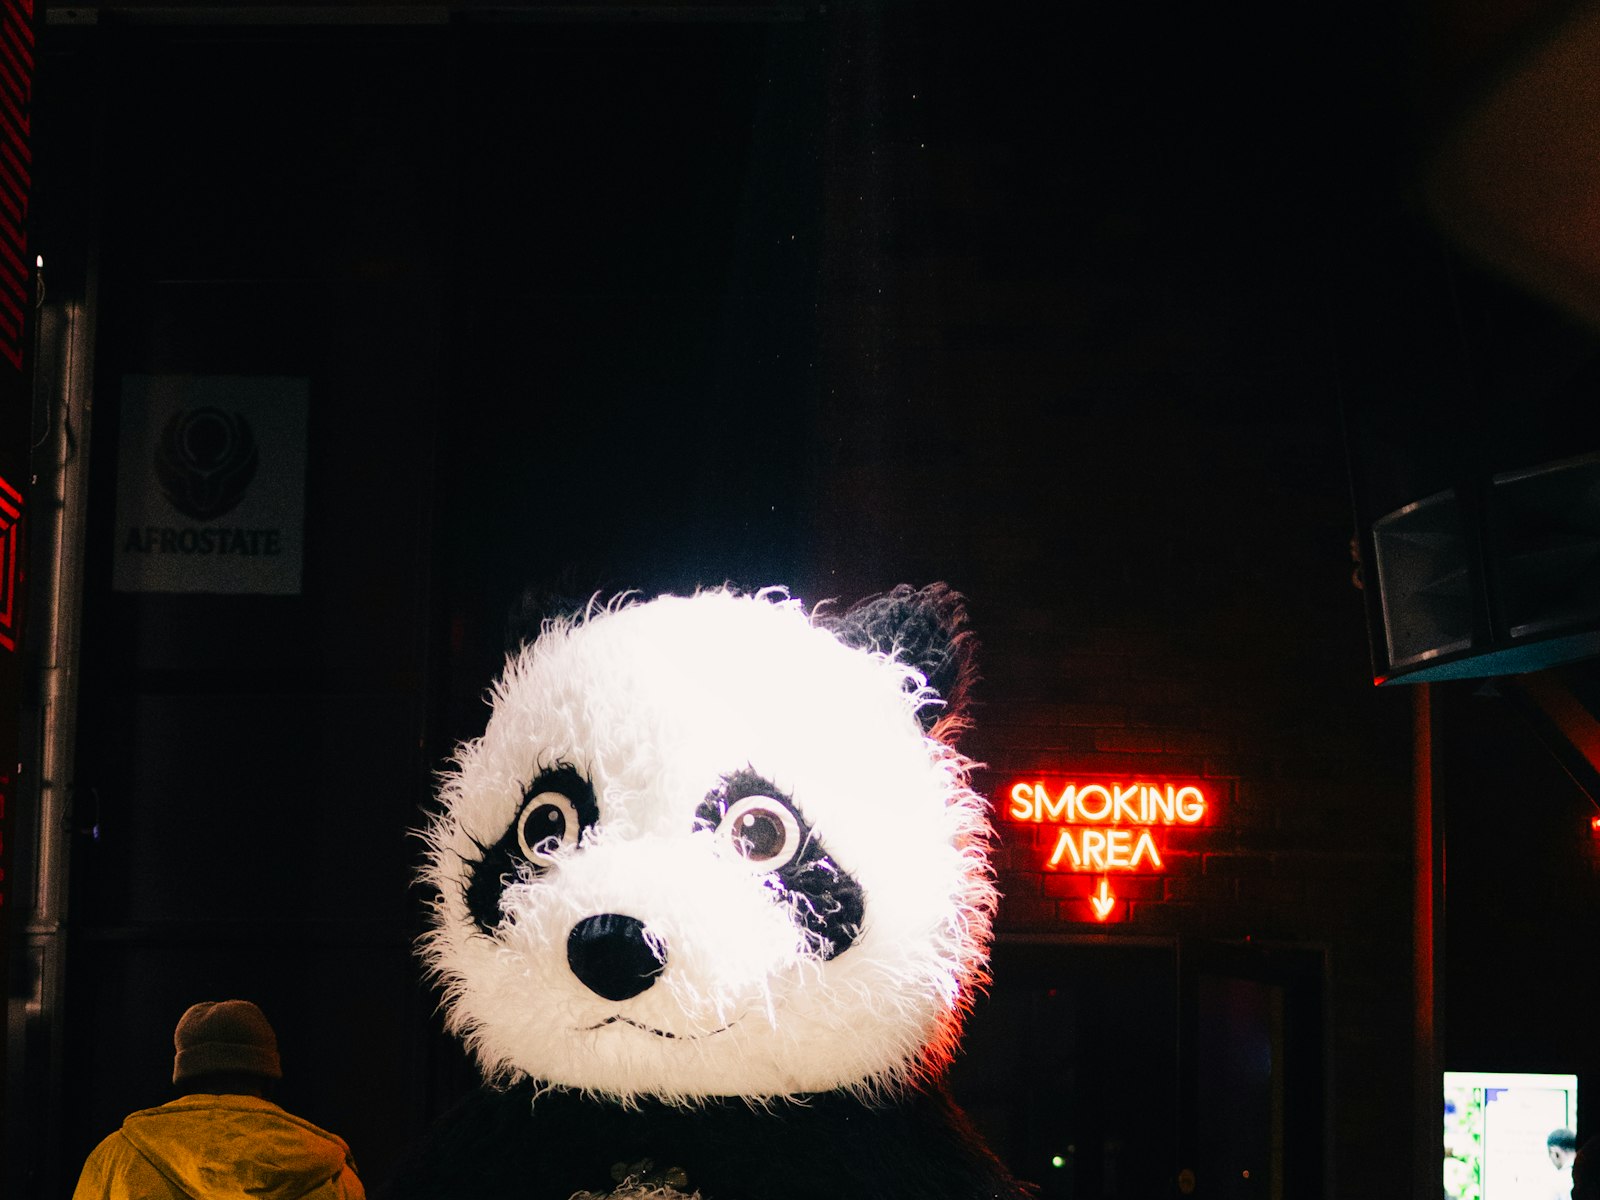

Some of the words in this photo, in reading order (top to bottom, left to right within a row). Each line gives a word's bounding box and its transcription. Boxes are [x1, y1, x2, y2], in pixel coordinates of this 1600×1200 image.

[125, 527, 282, 556] AFROSTATE
[1009, 782, 1207, 823] SMOKING
[1049, 830, 1162, 868] AREA
